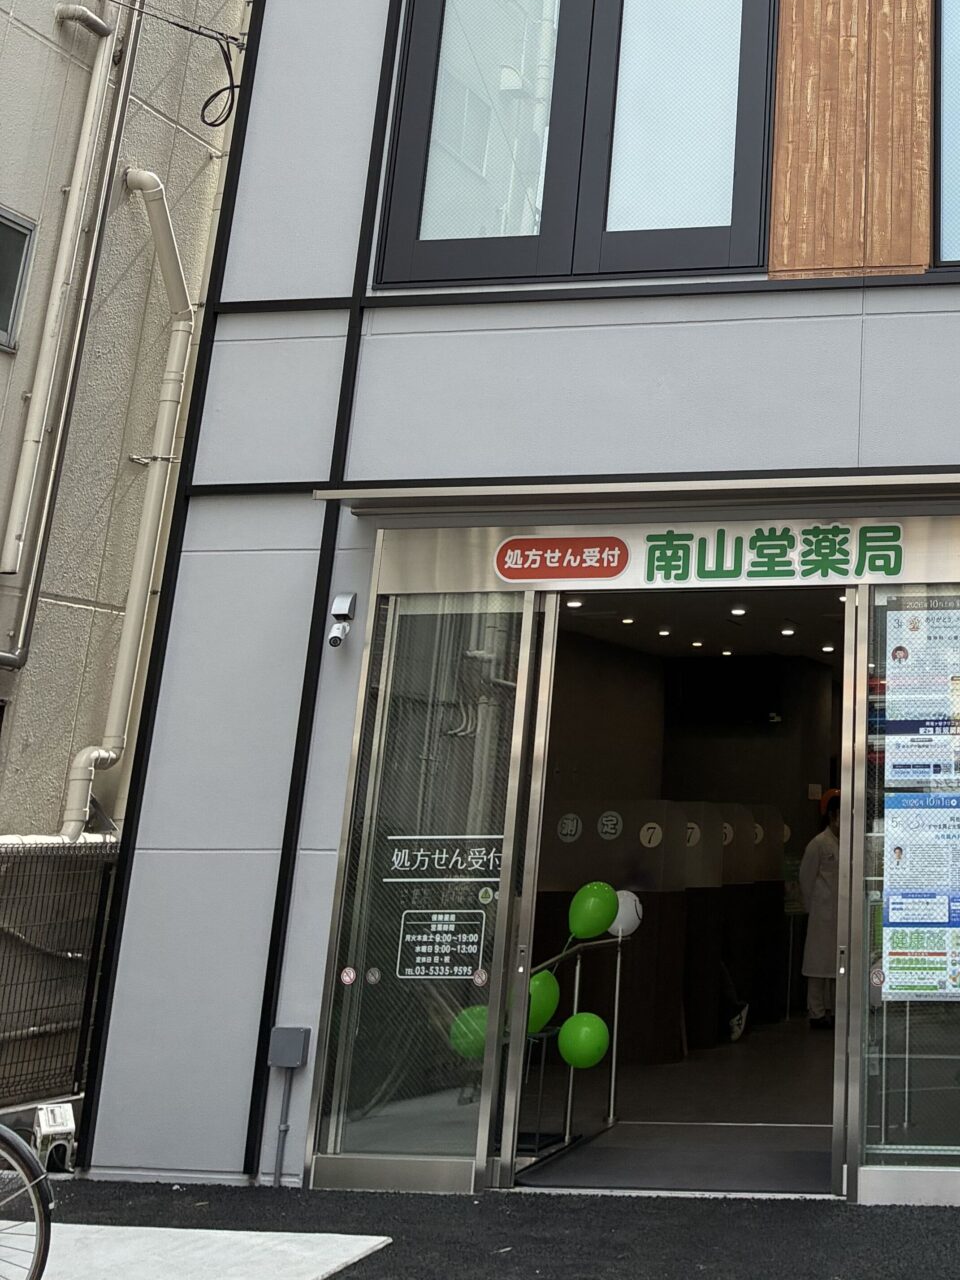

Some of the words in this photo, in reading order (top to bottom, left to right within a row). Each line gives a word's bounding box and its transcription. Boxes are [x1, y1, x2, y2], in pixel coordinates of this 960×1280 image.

[504, 546, 620, 569] 処方せん受付
[645, 524, 902, 582] 南山堂薬局
[646, 827, 656, 844] 7
[391, 847, 503, 871] 処方せん受付
